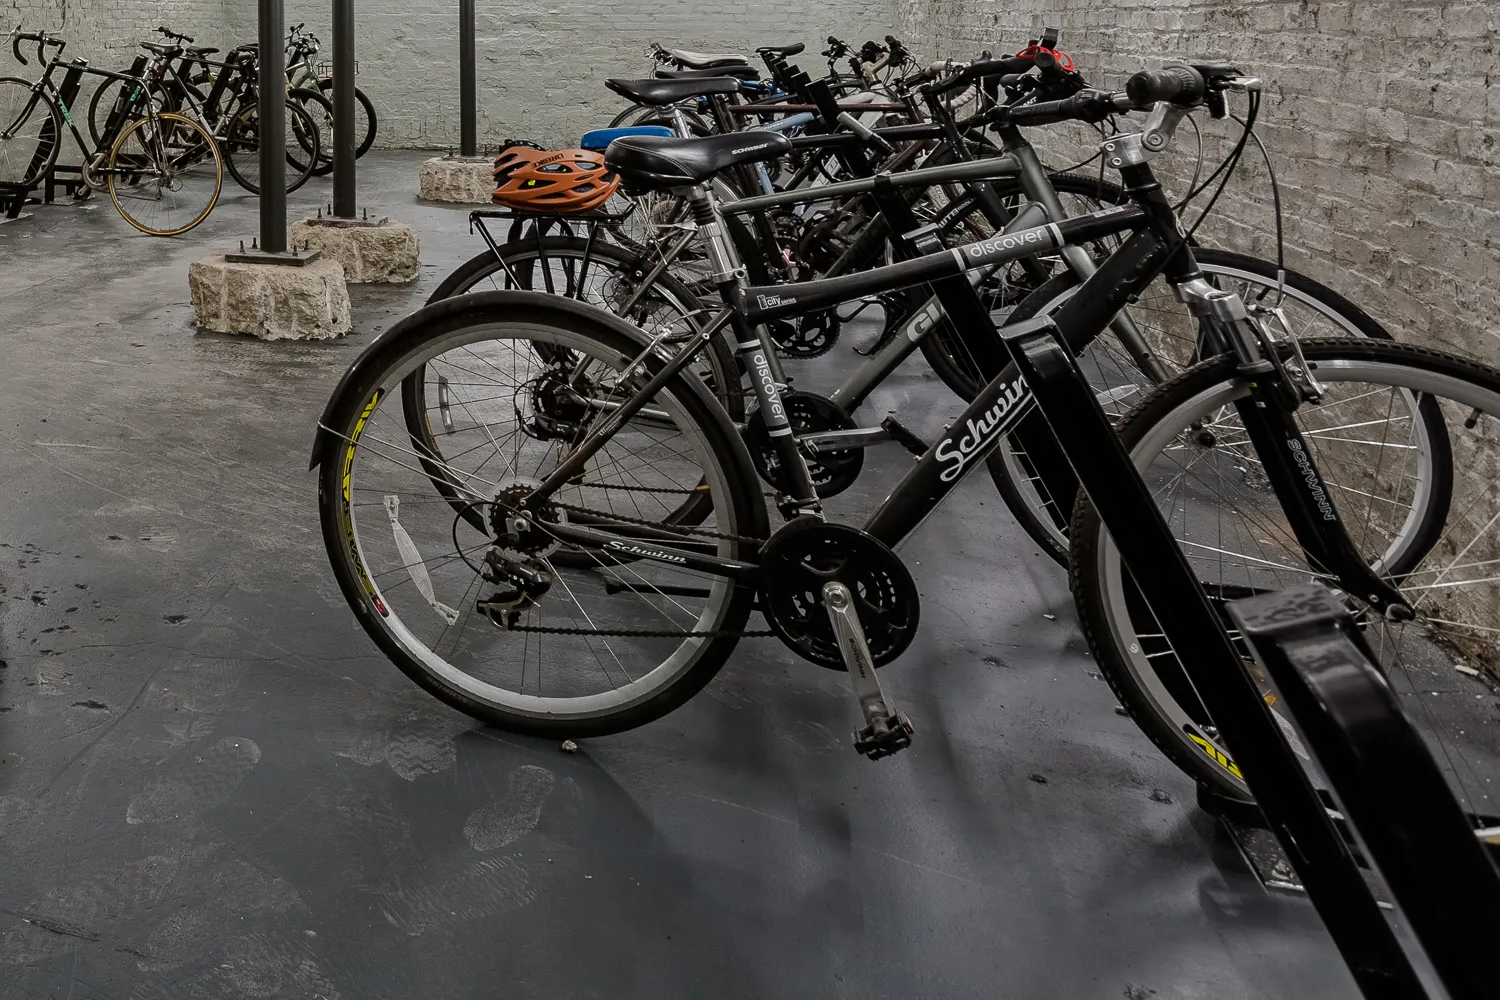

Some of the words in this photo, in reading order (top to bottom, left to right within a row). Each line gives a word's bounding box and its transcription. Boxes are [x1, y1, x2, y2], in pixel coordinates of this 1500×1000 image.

[58, 98, 75, 127] TREK
[731, 142, 769, 155] SCHWINN
[969, 228, 1044, 258] discover
[753, 354, 785, 420] discover
[935, 374, 1033, 482] Schwin
[1286, 438, 1337, 521] SCHWINN
[603, 540, 687, 564] Schwinn
